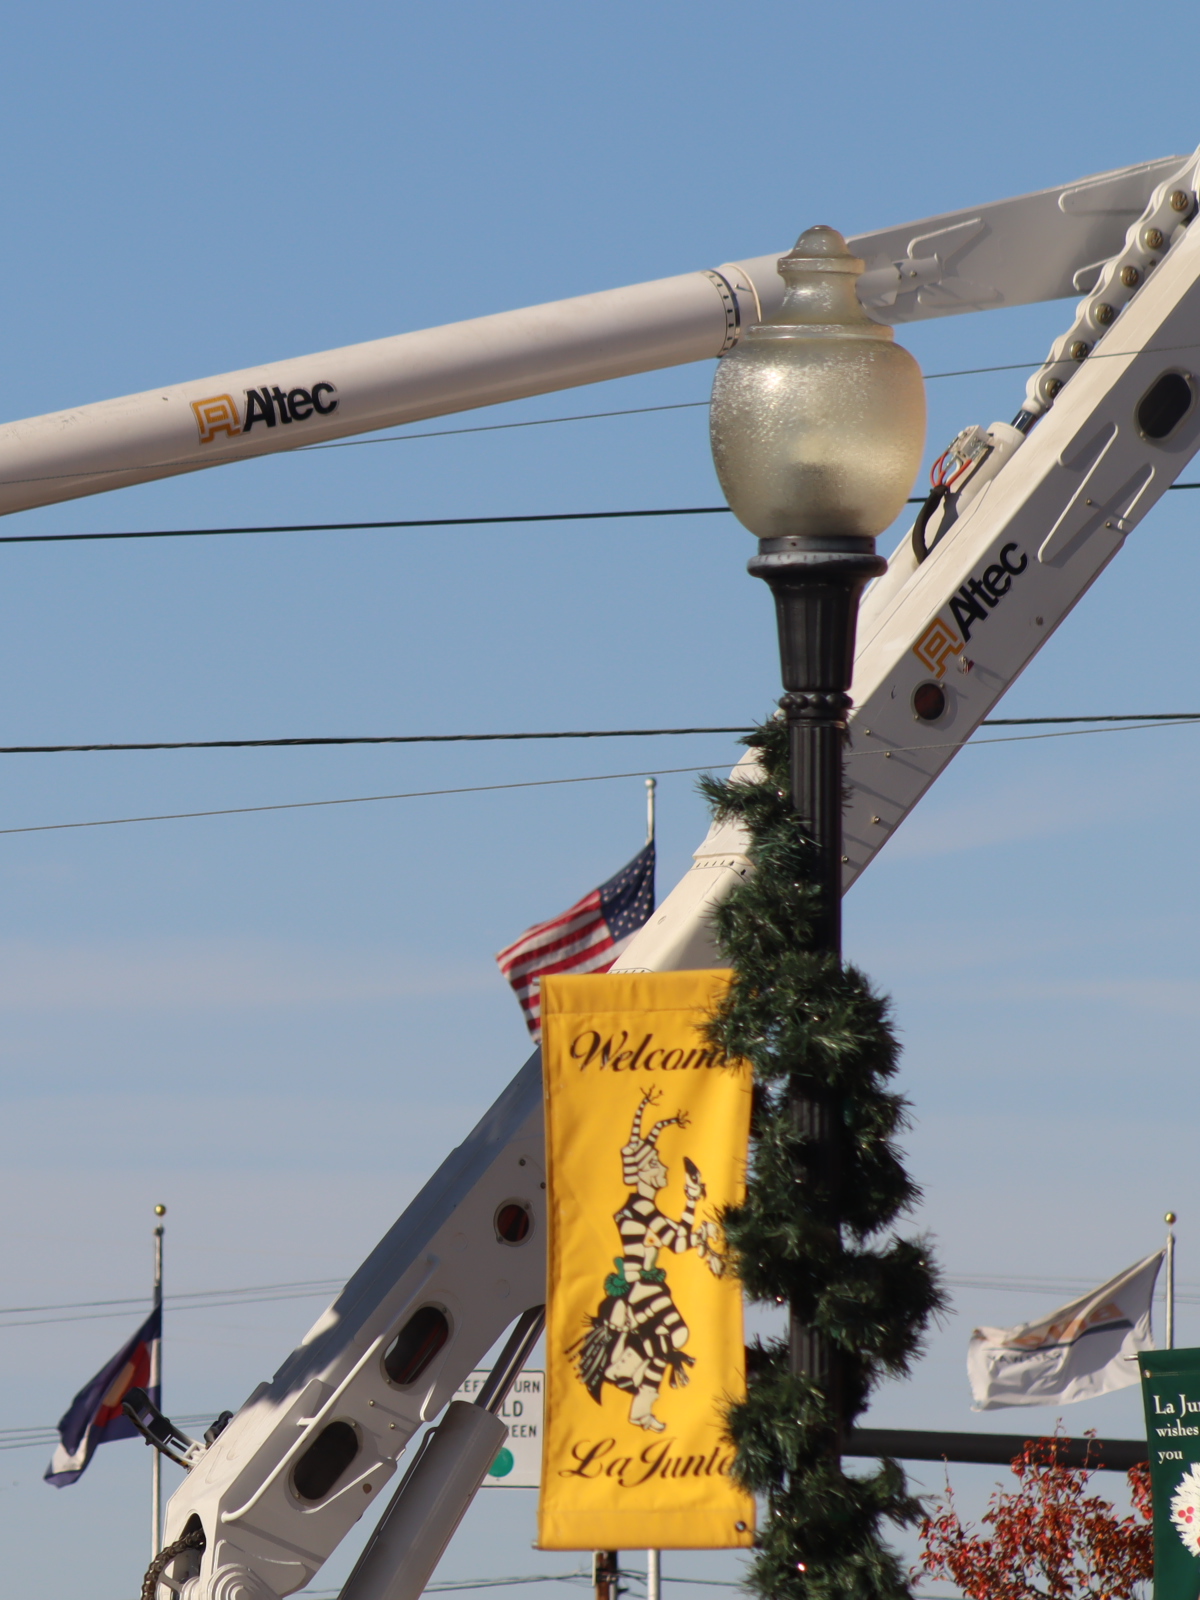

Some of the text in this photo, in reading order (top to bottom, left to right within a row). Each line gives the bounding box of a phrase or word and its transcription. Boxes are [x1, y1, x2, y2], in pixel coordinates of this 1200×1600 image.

[243, 382, 338, 433] Altec
[948, 542, 1028, 644] Altec
[456, 1379, 540, 1393] EF URN
[1153, 1394, 1176, 1415] La
[1155, 1418, 1200, 1437] wishes
[558, 1437, 633, 1479] La
[1157, 1450, 1184, 1465] you
